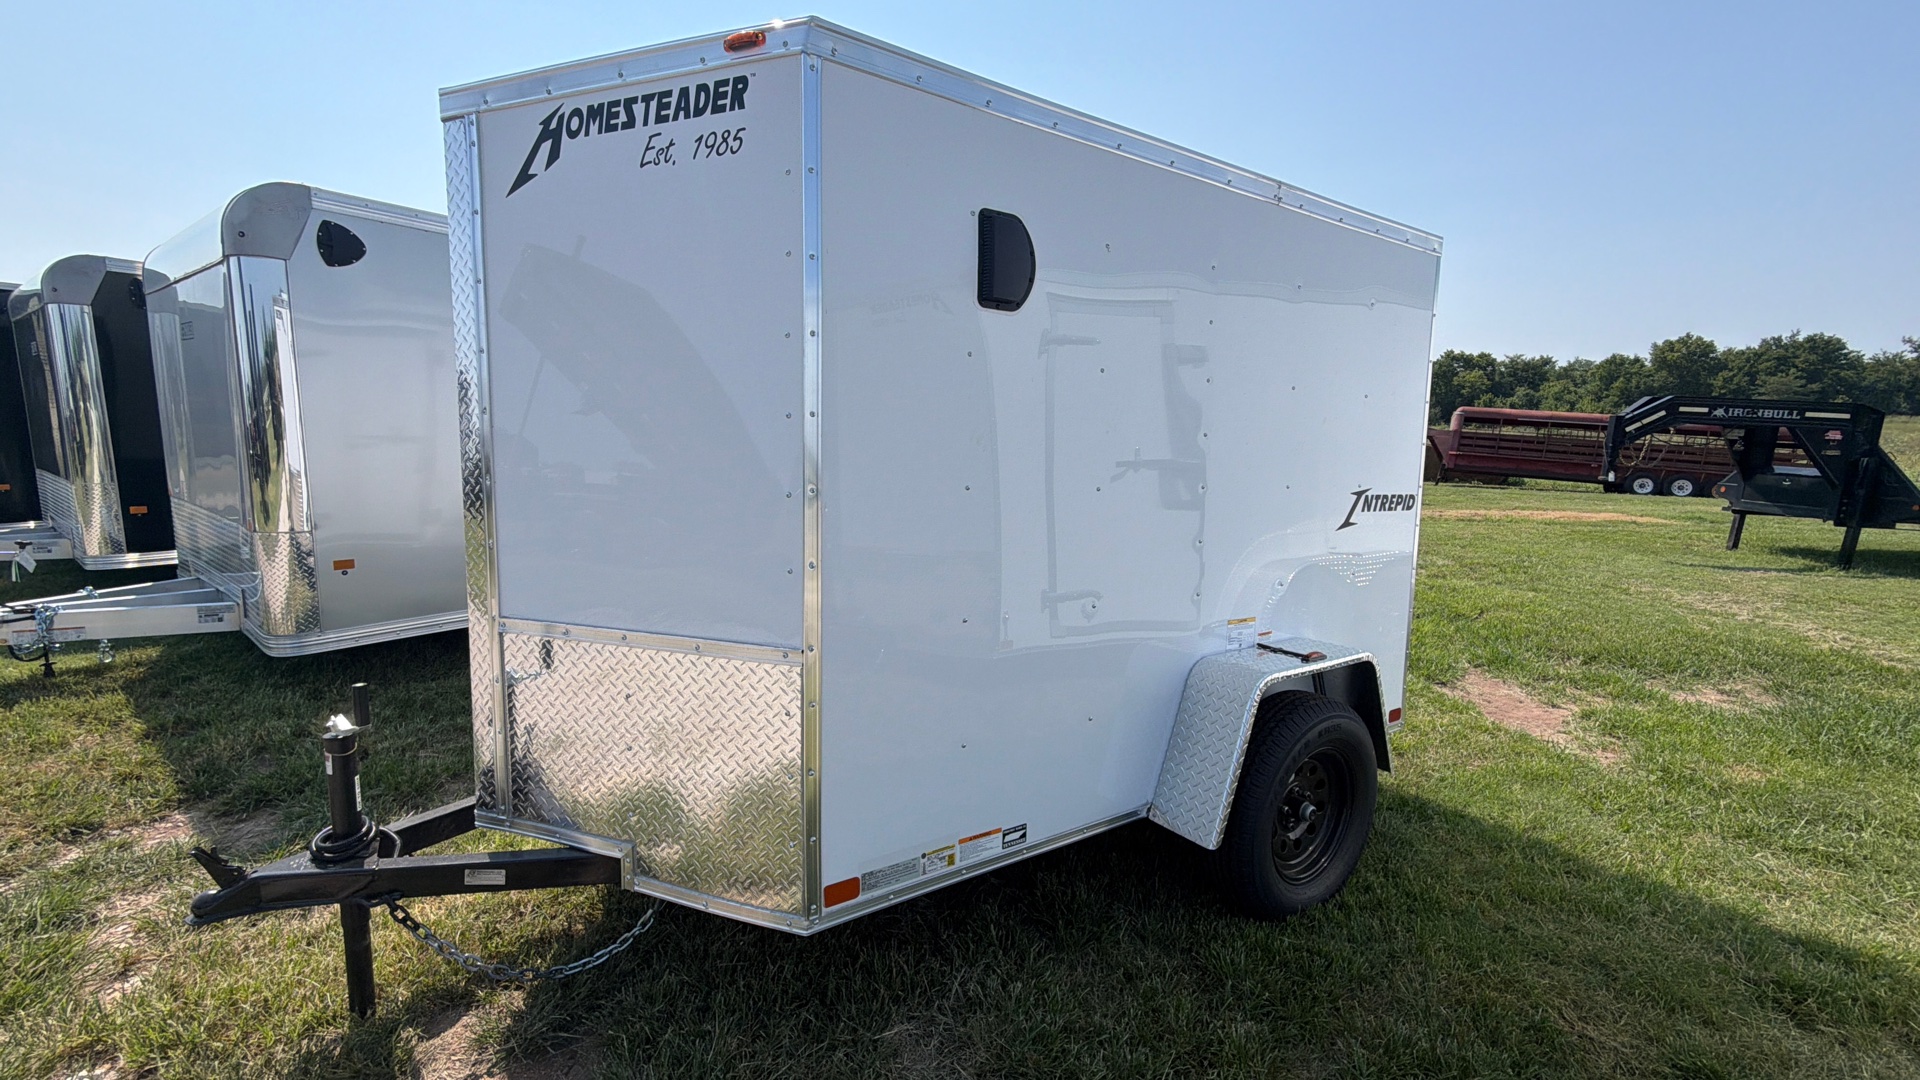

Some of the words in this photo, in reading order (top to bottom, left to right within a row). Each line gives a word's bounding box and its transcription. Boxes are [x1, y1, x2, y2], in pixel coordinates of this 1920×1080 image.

[506, 74, 749, 198] HOMESTEADER
[692, 127, 747, 160] 1985
[1335, 487, 1416, 532] INTREPID
